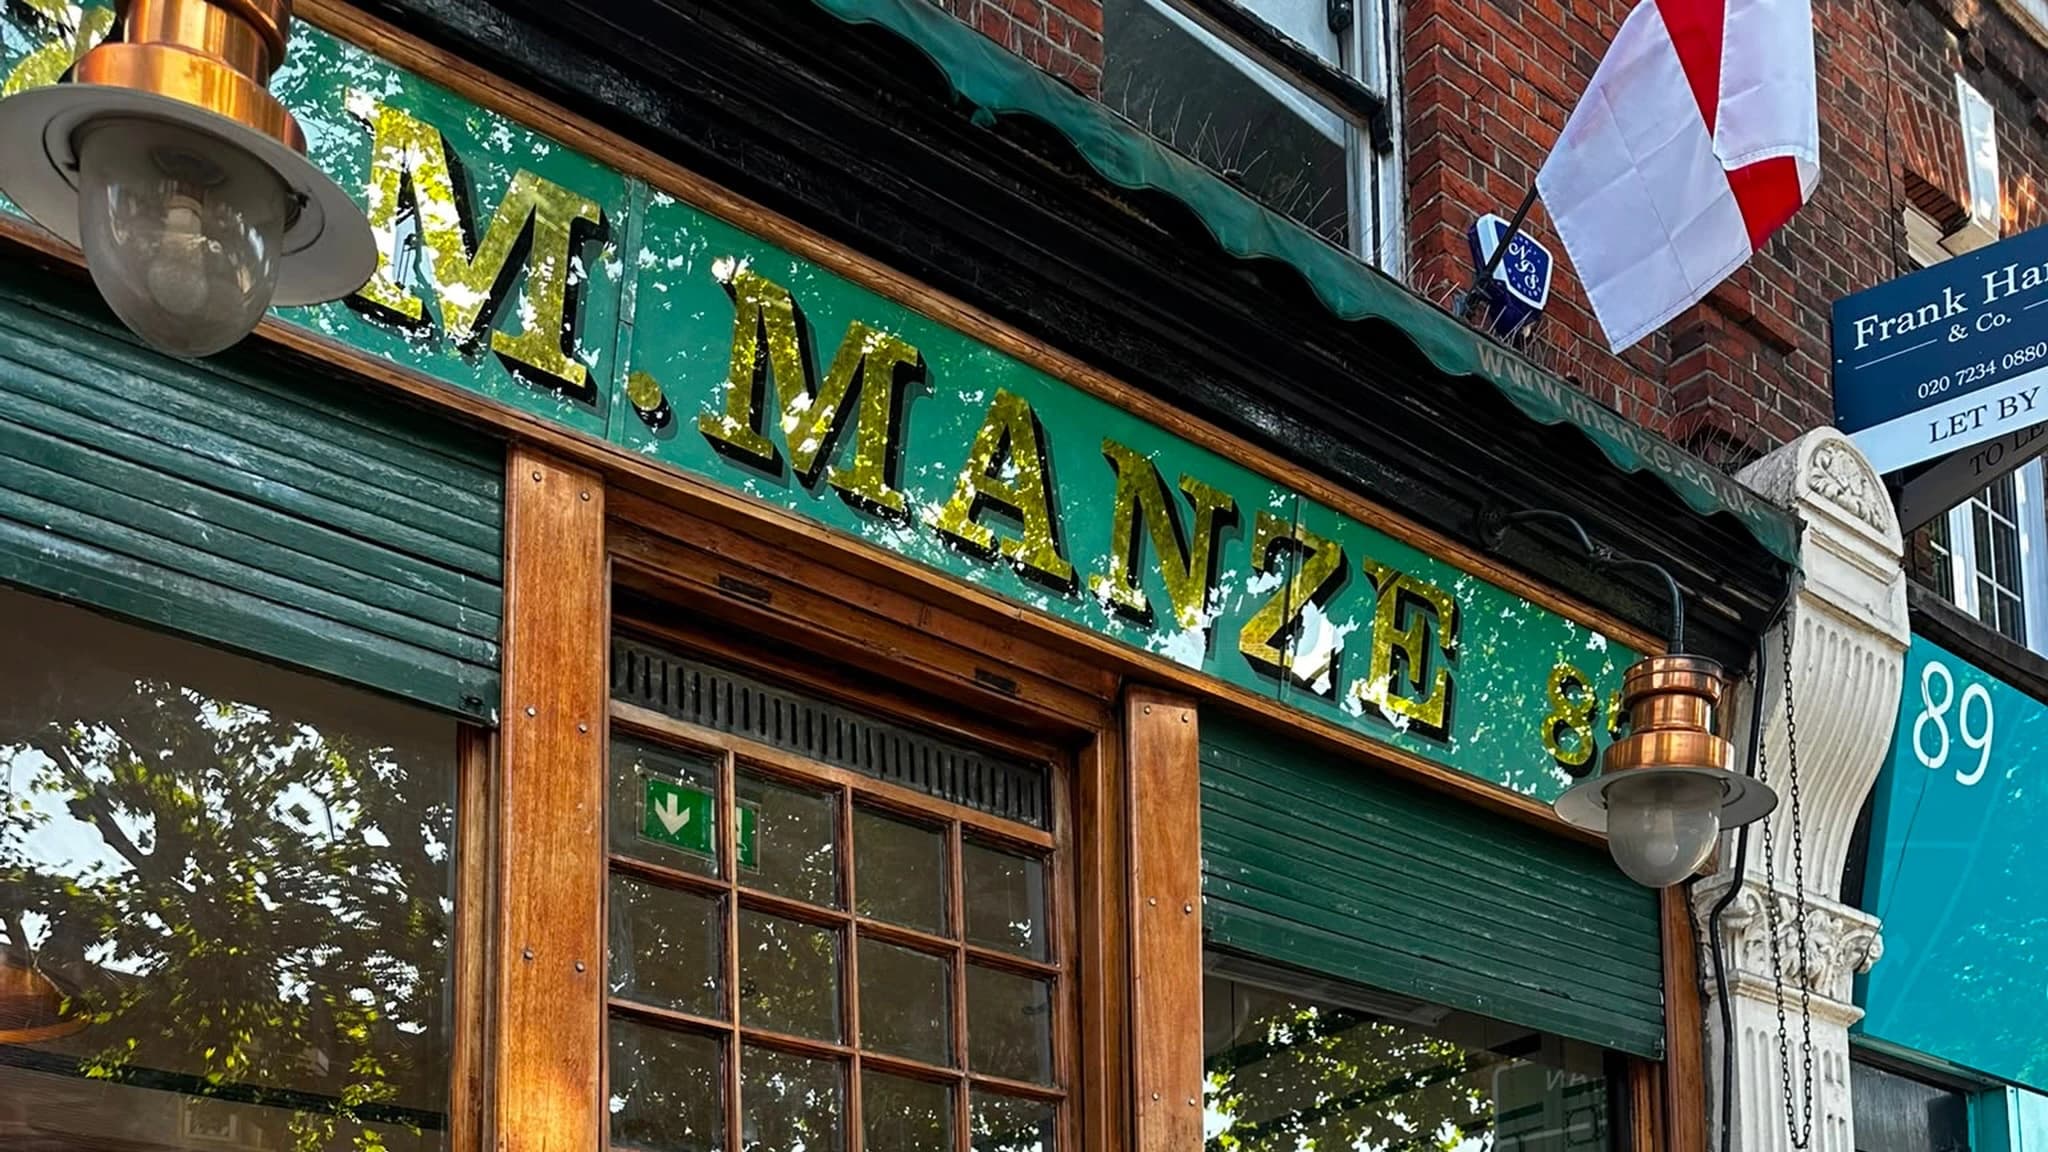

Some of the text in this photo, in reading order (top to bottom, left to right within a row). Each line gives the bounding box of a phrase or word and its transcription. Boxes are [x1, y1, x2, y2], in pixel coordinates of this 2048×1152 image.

[1853, 286, 1968, 350] Frank
[1948, 312, 2012, 342] & Co.
[1918, 342, 2047, 398] 020 7234 0880
[1476, 341, 1761, 521] www.manze.co.uk
[1929, 386, 2040, 444] LET BY
[1969, 442, 2004, 477] TO
[698, 256, 1454, 730] MANZE
[1540, 664, 1622, 768] 8
[1912, 660, 1994, 786] 89
